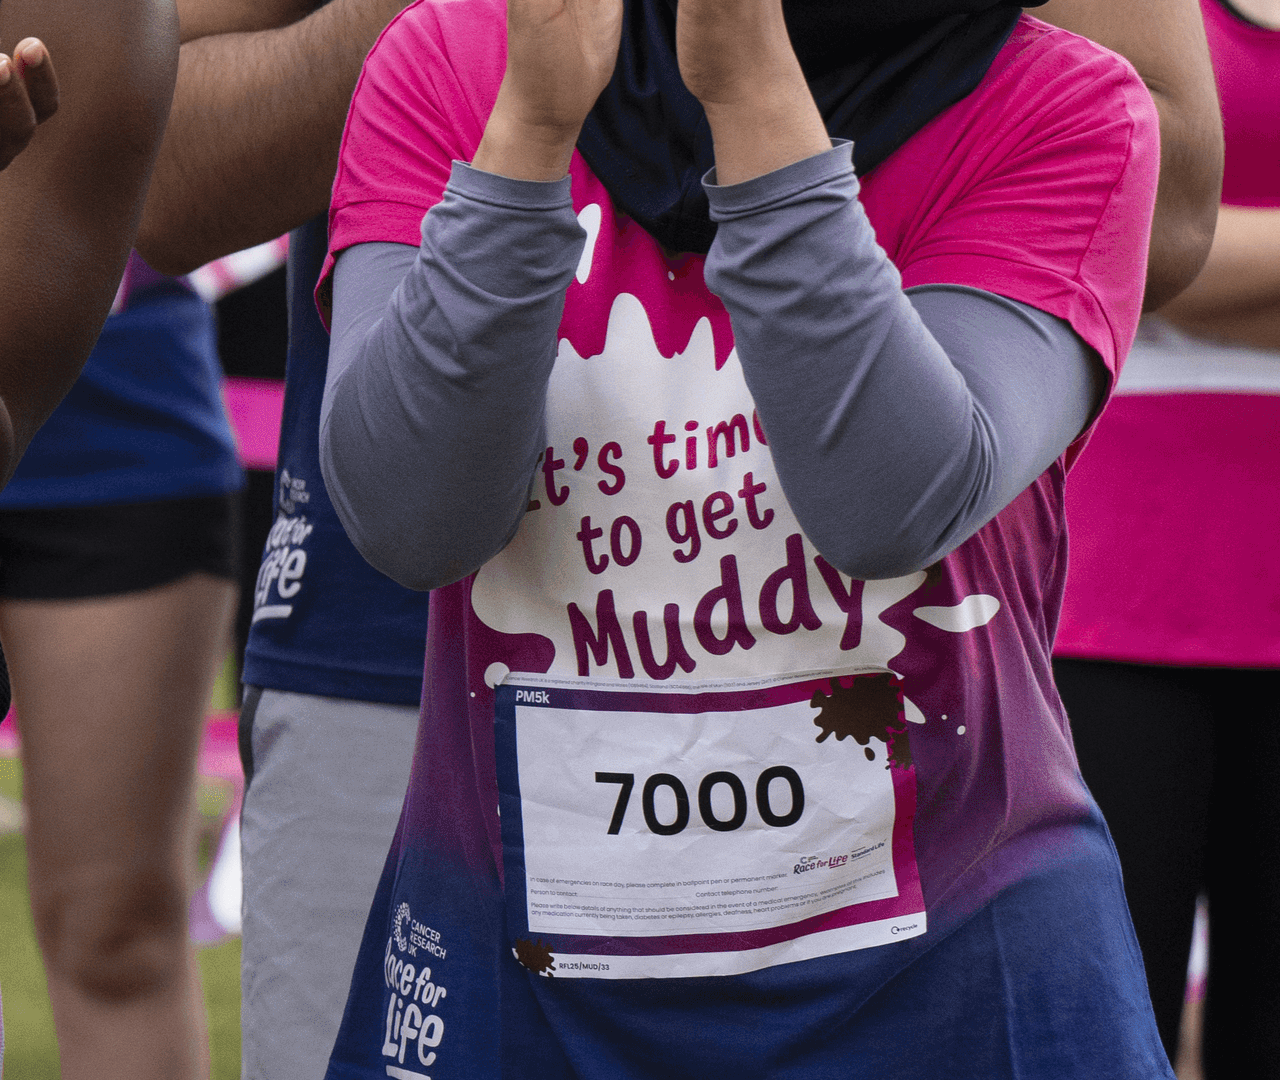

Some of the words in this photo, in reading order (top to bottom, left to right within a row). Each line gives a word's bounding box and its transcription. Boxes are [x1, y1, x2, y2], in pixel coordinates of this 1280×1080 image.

[523, 436, 626, 513] t's
[576, 515, 643, 575] to
[665, 471, 775, 564] get
[566, 533, 866, 681] Muddy
[515, 690, 550, 706] PM5k
[595, 765, 806, 838] 7000
[793, 862, 816, 875] Race
[827, 854, 849, 867] Life
[409, 930, 447, 960] RESEARCH
[410, 919, 441, 944] CANCER
[407, 943, 418, 958] UK
[558, 961, 610, 972] RFL25/MUD/33
[413, 967, 447, 1008] for
[382, 992, 445, 1067] Life
